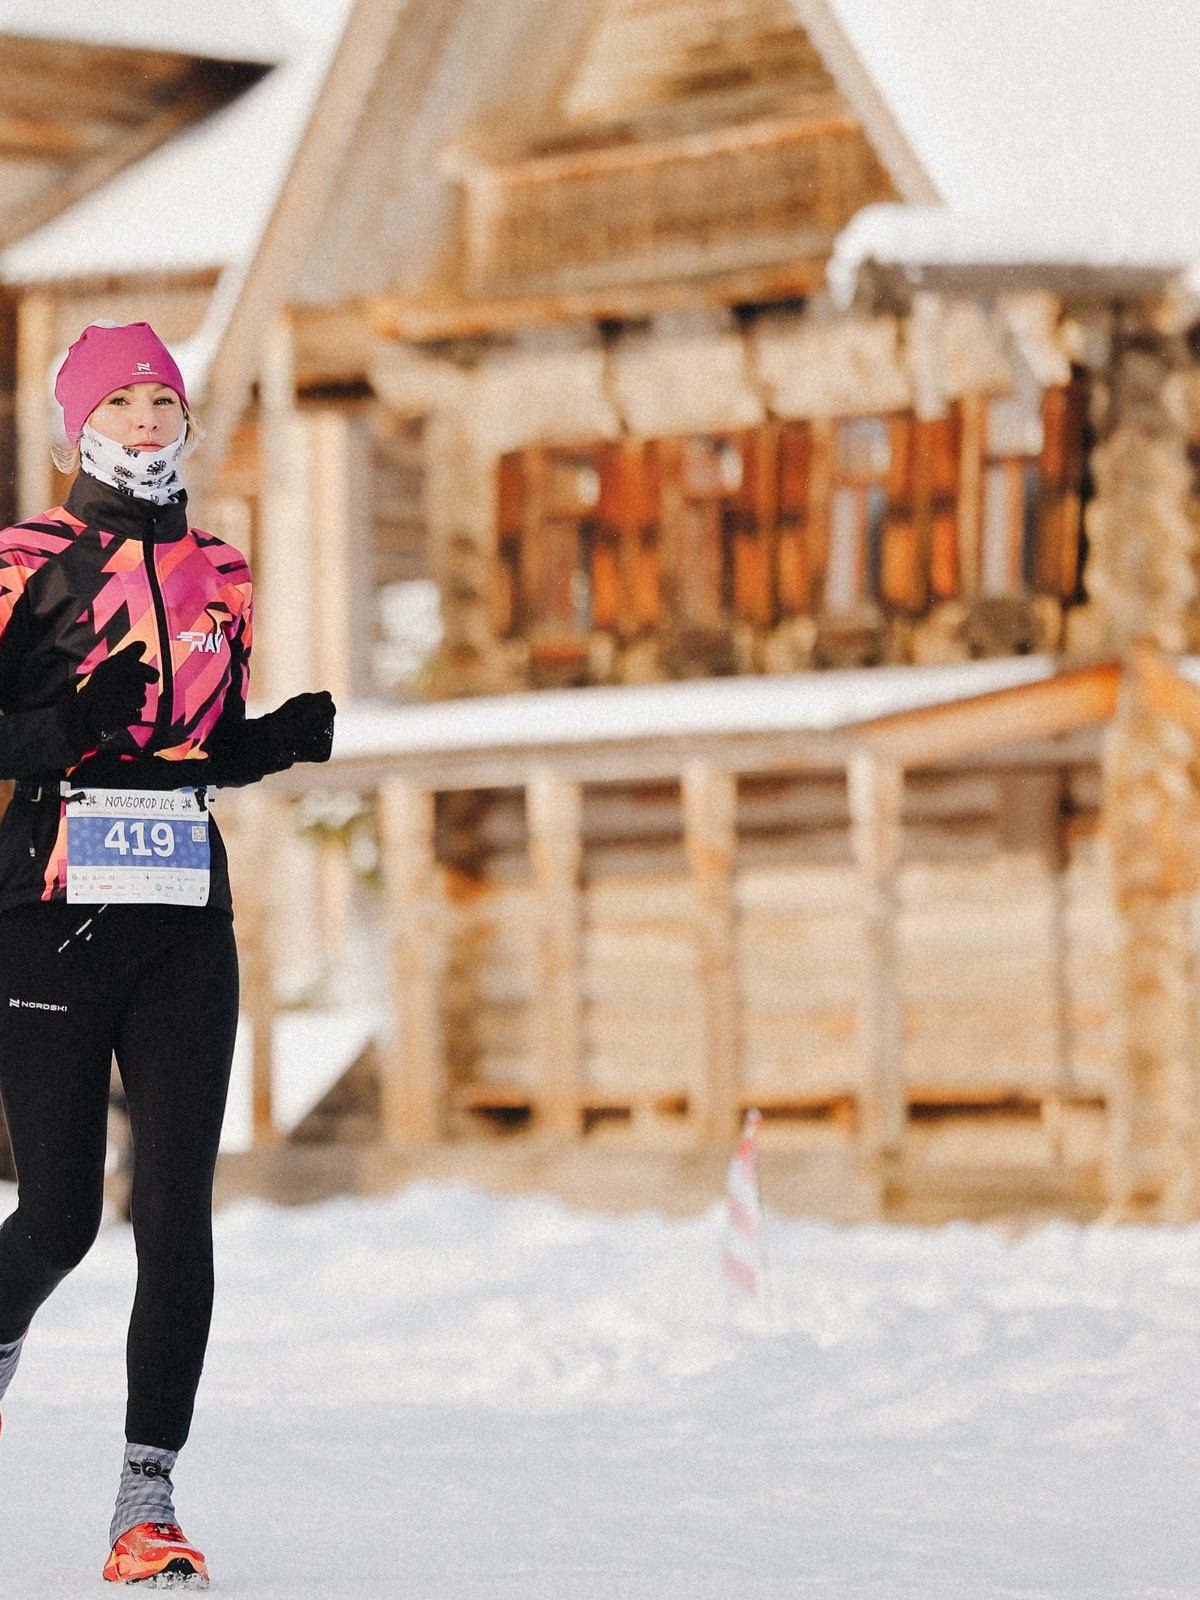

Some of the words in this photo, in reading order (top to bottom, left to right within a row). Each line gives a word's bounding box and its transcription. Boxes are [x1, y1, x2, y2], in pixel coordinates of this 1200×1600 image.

[105, 796, 157, 809] NOVGOROD
[159, 798, 175, 811] ICE
[104, 821, 175, 858] 419
[21, 1000, 68, 1012] NORDSKI
